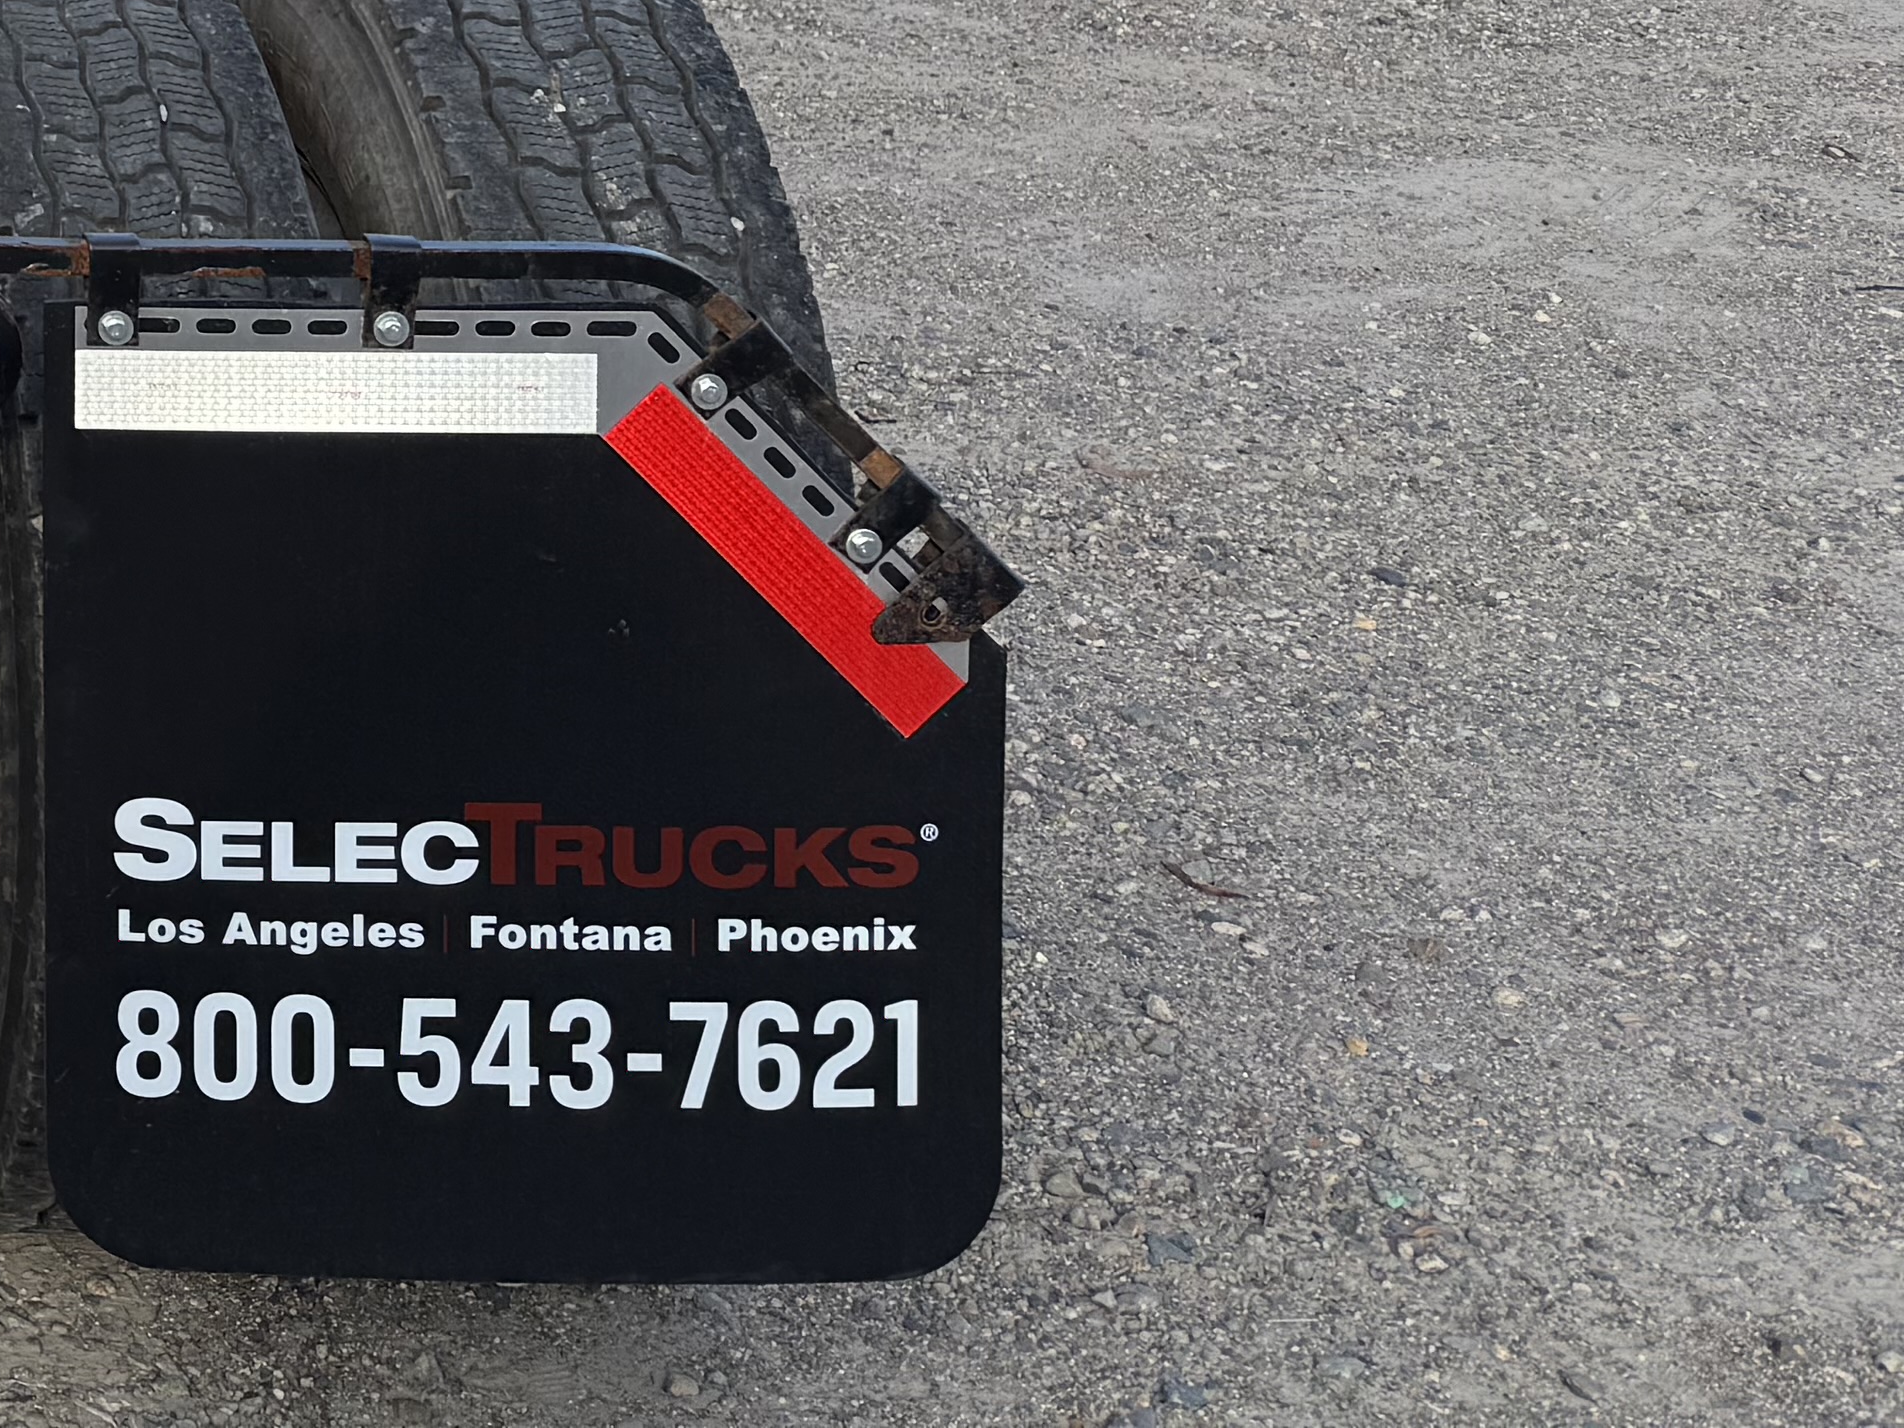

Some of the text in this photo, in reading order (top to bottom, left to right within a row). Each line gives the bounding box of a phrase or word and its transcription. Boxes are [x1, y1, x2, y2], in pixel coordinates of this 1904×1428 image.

[117, 908, 918, 956] Los Angeles Fontana Phoenix
[115, 989, 919, 1112] 800-543-7621
